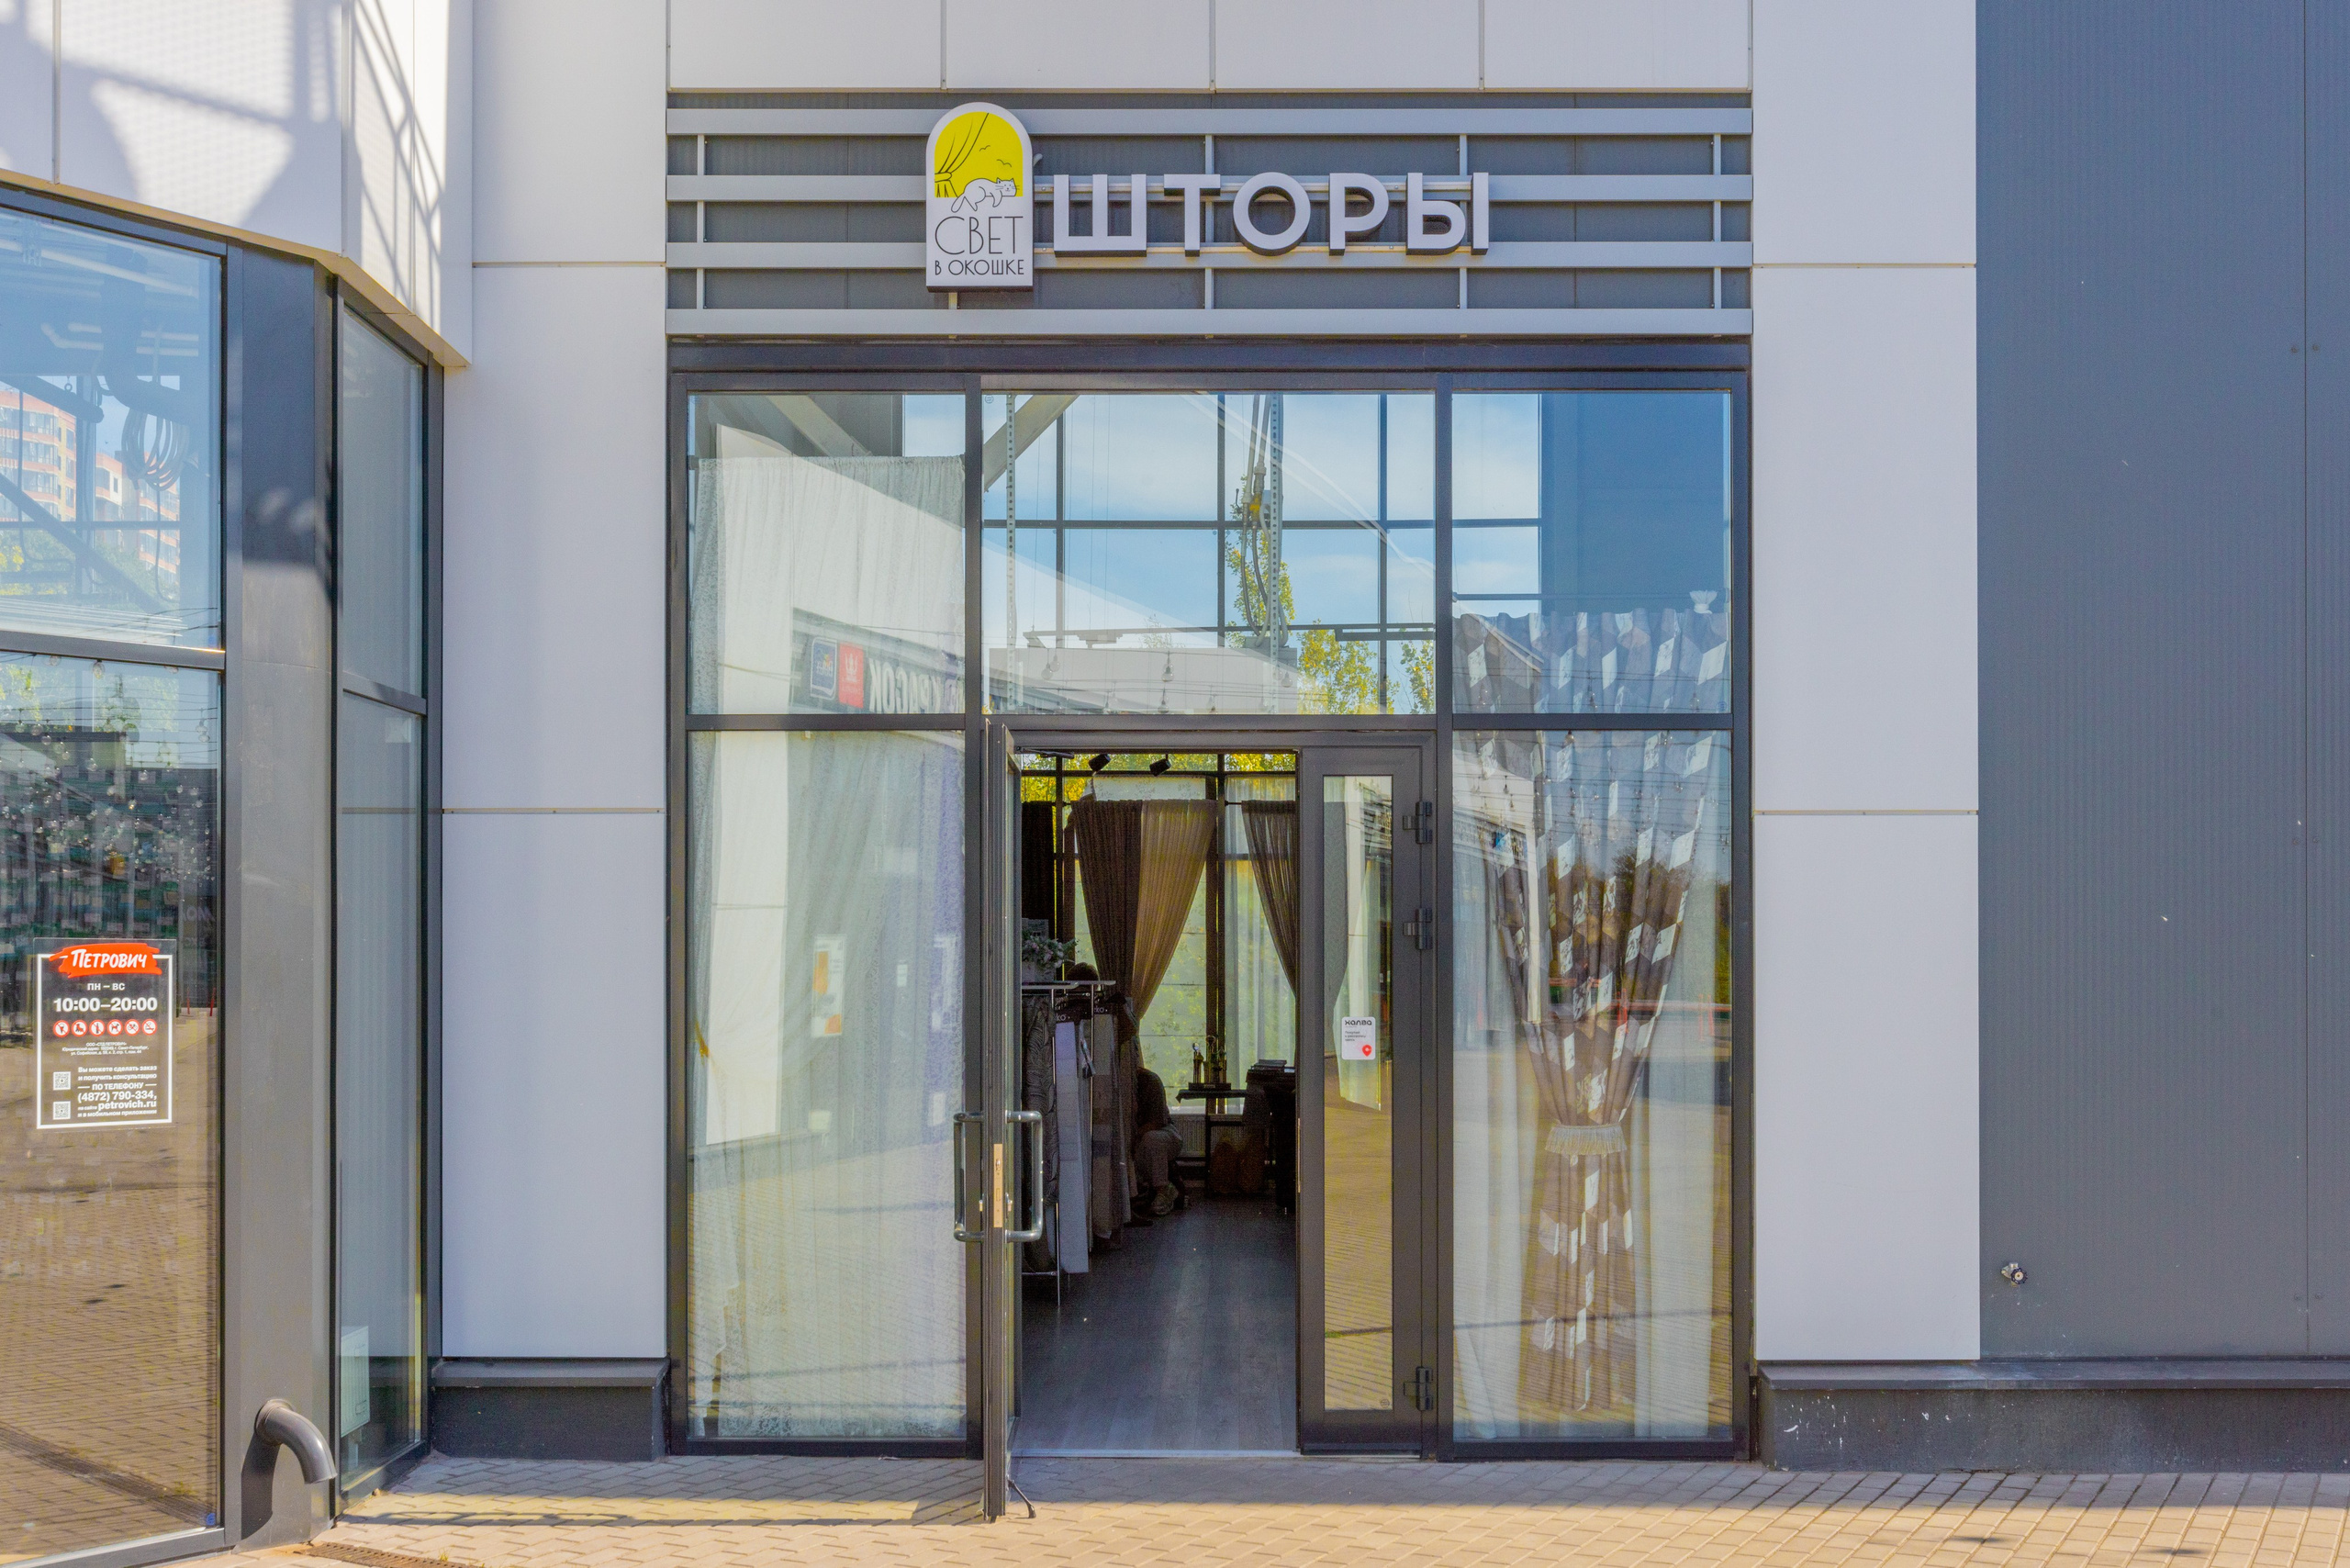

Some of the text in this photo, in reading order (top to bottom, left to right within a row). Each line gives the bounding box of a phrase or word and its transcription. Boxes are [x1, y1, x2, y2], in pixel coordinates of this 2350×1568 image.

[1053, 172, 1491, 257] ШТОРЫ
[934, 216, 1024, 255] СВЕТ
[934, 259, 1024, 275] В ОКОШКЕ
[77, 1090, 157, 1103] (4872) 790-334,
[98, 1100, 157, 1111] petrovich.ru
